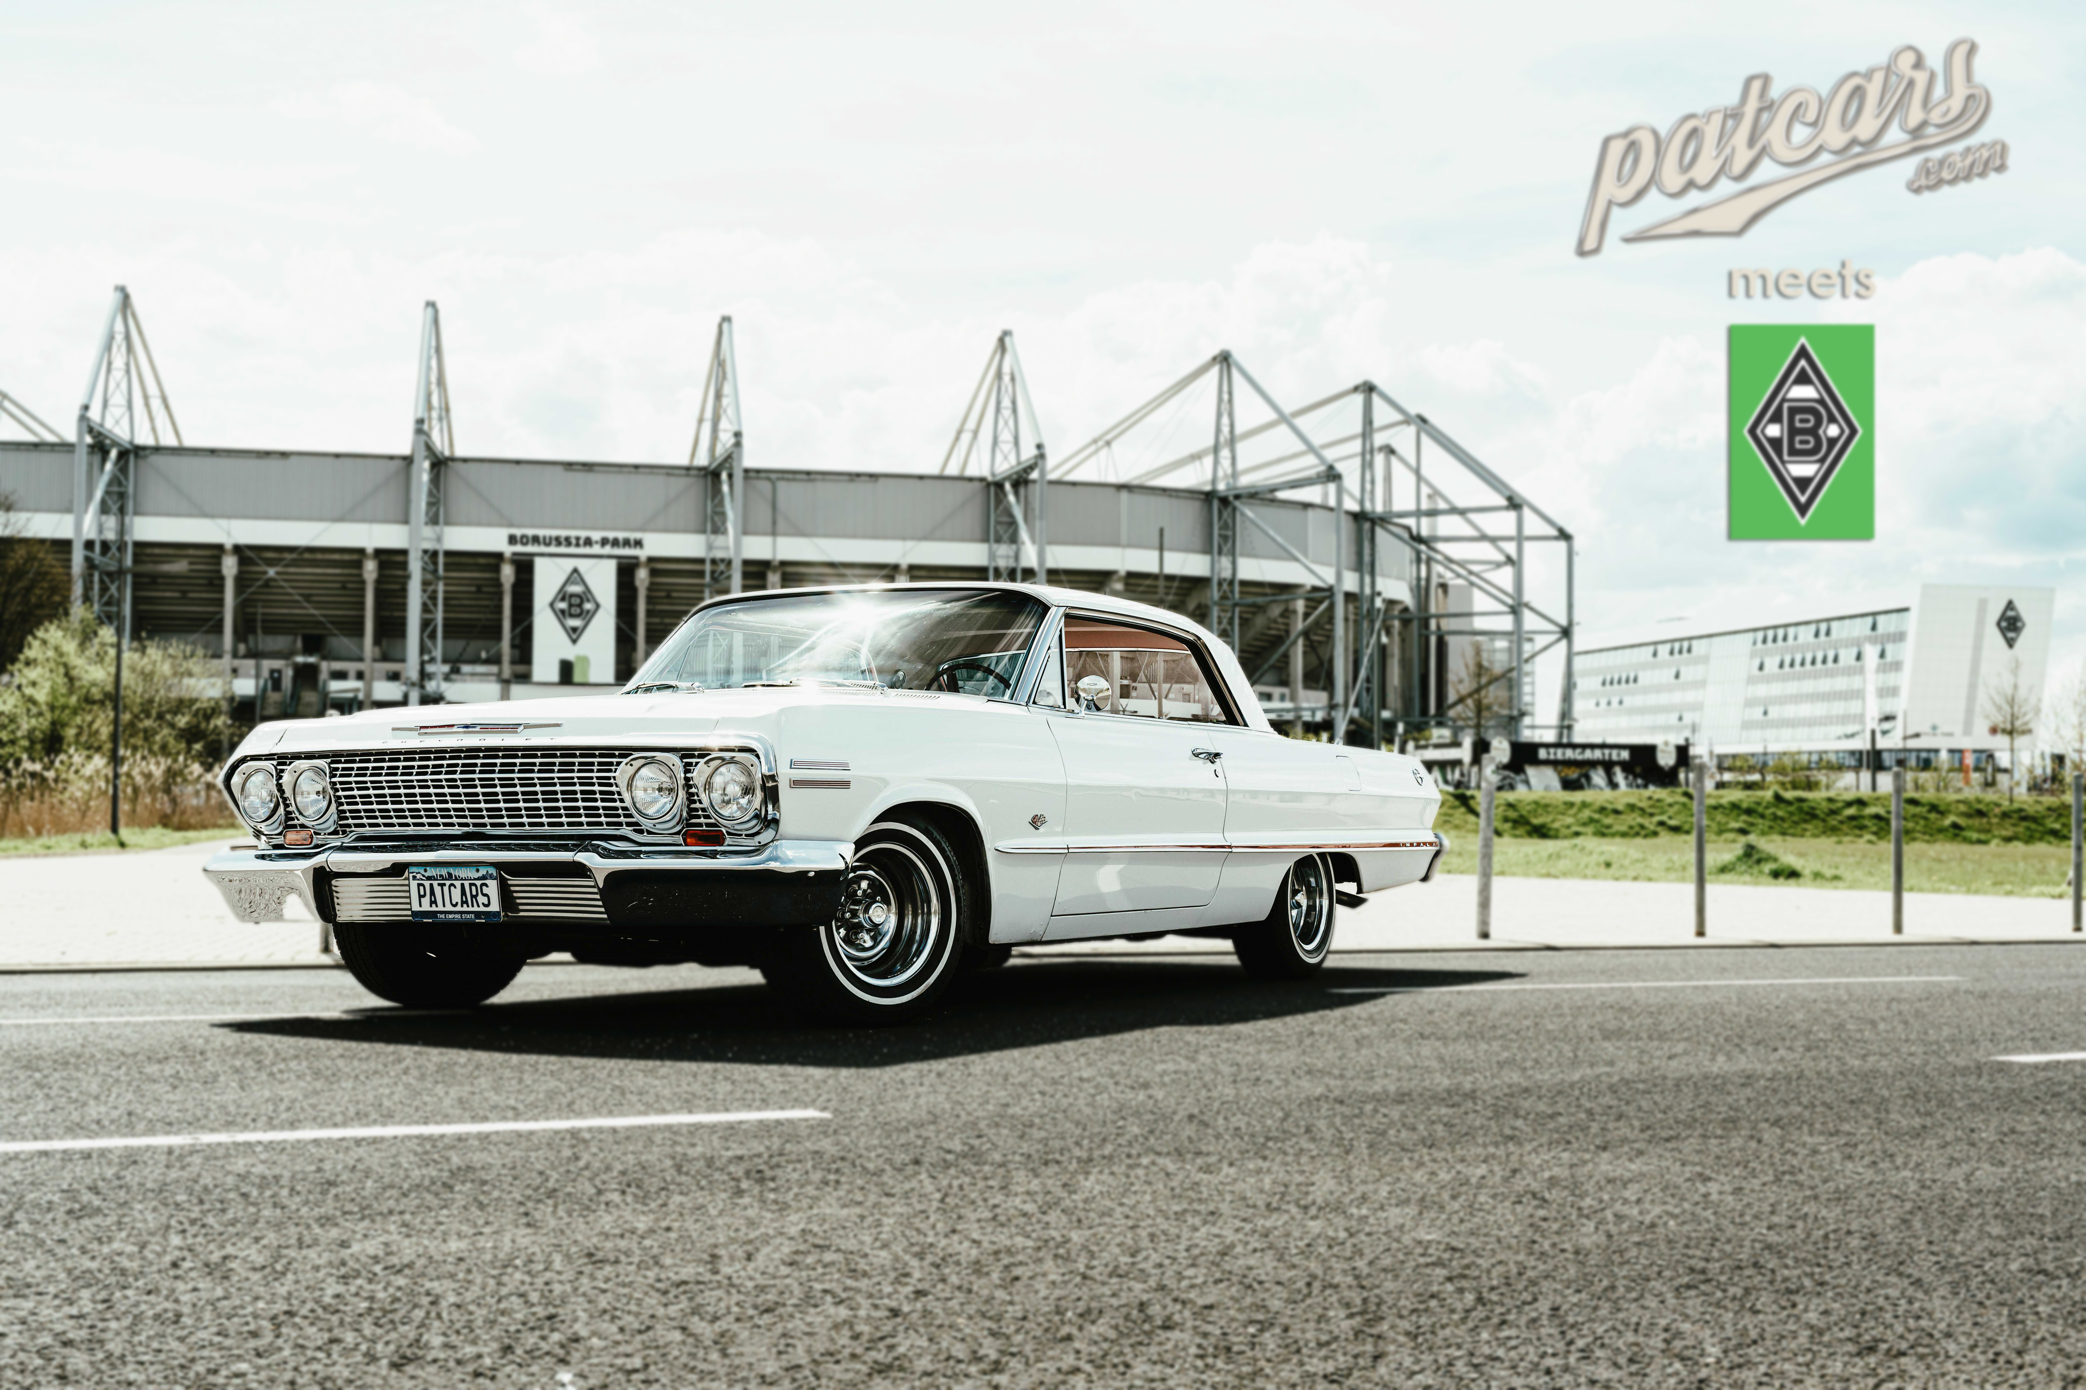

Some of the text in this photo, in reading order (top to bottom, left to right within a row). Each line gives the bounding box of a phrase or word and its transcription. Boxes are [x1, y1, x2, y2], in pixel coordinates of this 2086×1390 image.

[508, 533, 644, 550] BORUSSIA-PARK
[1538, 748, 1630, 761] BIERGARTEN
[431, 867, 474, 880] NEW YORK
[417, 882, 491, 908] PATCARS
